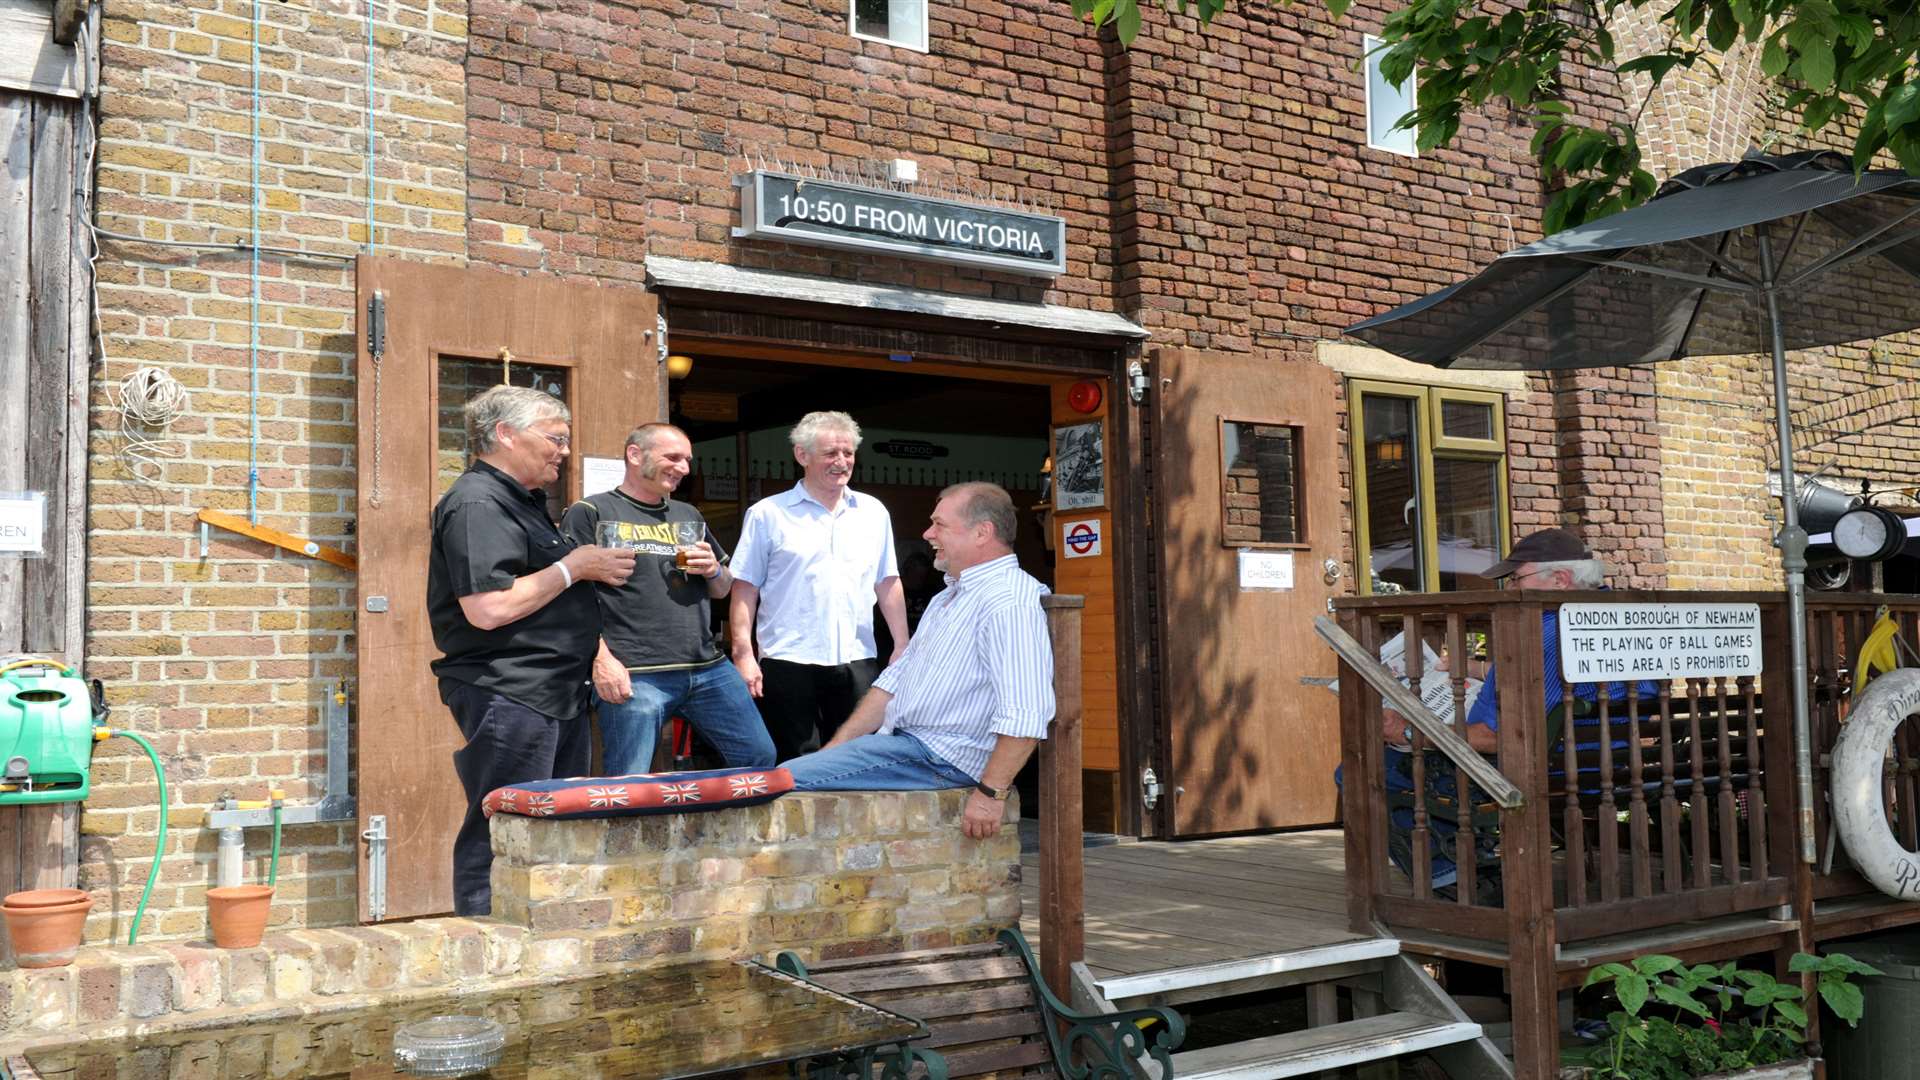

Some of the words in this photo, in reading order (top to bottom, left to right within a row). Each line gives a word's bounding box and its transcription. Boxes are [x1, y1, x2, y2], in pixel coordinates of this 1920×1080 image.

[779, 194, 847, 225] 10:50
[854, 205, 928, 237] FROM
[934, 216, 1044, 252] VICTORIA
[1568, 611, 1618, 626] LONDON
[1624, 611, 1680, 625] BOROUGH
[1686, 611, 1699, 624] OF
[1705, 610, 1755, 624] NEWHAM
[1572, 638, 1596, 652] THE
[1602, 637, 1654, 651] PLAYING
[1659, 636, 1673, 650] OF
[1680, 636, 1708, 649] BALL
[1714, 635, 1753, 648] GAMES
[1578, 659, 1590, 673] IN
[1597, 658, 1625, 673] THIS
[1631, 657, 1664, 672] AREA
[1670, 657, 1681, 671] IS
[1686, 655, 1750, 670] PROHIBITED
